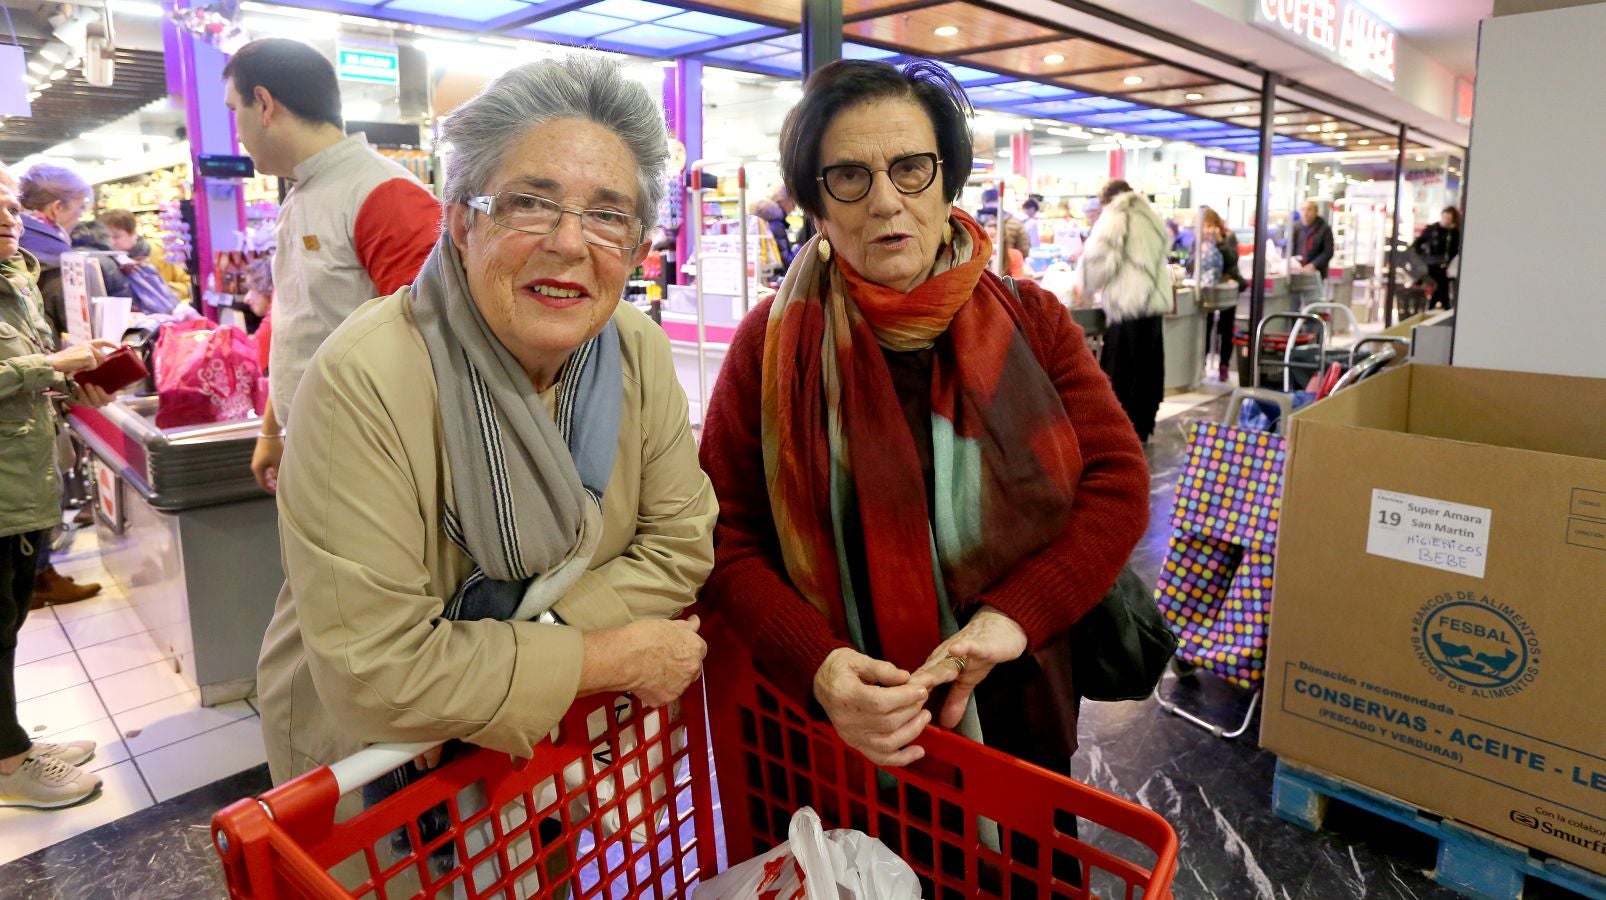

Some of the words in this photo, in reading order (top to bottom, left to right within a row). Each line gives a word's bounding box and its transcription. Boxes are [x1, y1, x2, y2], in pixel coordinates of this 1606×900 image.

[1378, 510, 1402, 527] 19
[1408, 503, 1441, 517] Super
[1442, 509, 1482, 525] Amara
[1411, 519, 1431, 530] San
[1418, 547, 1467, 568] BEBE
[1412, 592, 1454, 626] BANCOS
[1456, 591, 1475, 600] DE
[1480, 595, 1541, 655] ALIMENTOS
[1439, 616, 1511, 644] FESBAL
[1411, 636, 1446, 682] BANCOS
[1448, 681, 1466, 693] DE
[1472, 666, 1539, 699] ALIMENTOS
[1299, 661, 1357, 686] Donación
[1360, 681, 1455, 716] recomendada
[1294, 679, 1428, 733] CONSERVAS
[1448, 728, 1546, 772] ACEITE
[1572, 766, 1606, 793] LE
[1319, 708, 1376, 733] (PESCADO
[1380, 727, 1388, 736] Y
[1391, 731, 1464, 763] VERDURAS)
[1535, 806, 1555, 819] Con
[1556, 813, 1566, 823] la
